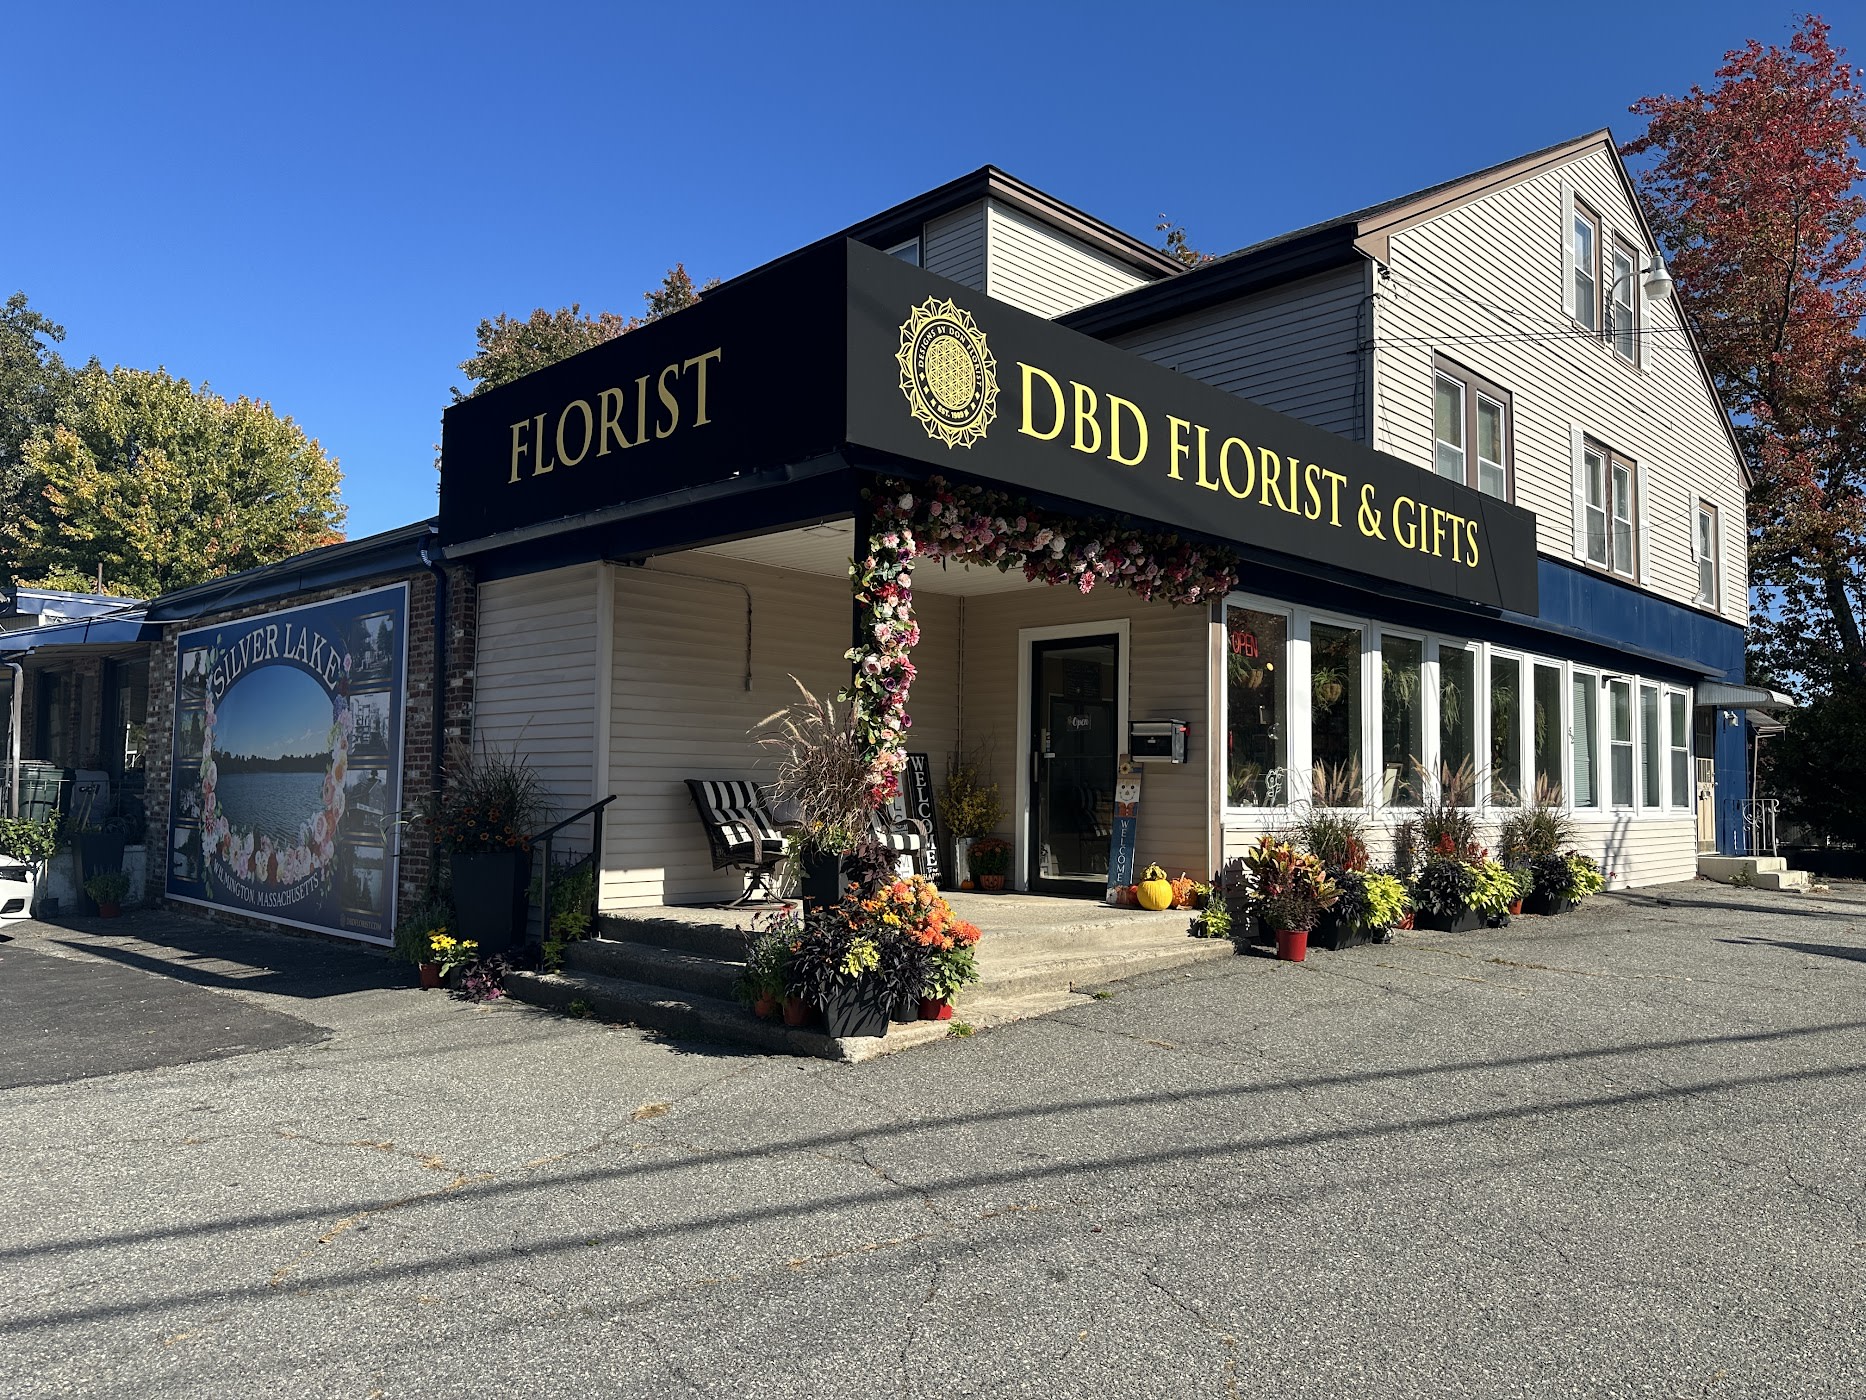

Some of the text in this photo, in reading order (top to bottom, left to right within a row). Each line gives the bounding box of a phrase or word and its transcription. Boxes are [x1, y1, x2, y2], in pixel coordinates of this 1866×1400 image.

[918, 326, 982, 387] DESIGNS BY DON FLORIST
[508, 346, 722, 484] FLORIST
[1017, 361, 1480, 568] DBD FLORIST & GIFTS
[212, 623, 341, 700] SILVER LAKE
[1232, 631, 1259, 658] OPEN
[1072, 716, 1089, 730] Open
[1116, 819, 1130, 882] WELCOME
[256, 872, 320, 907] MASSACHUSETTS
